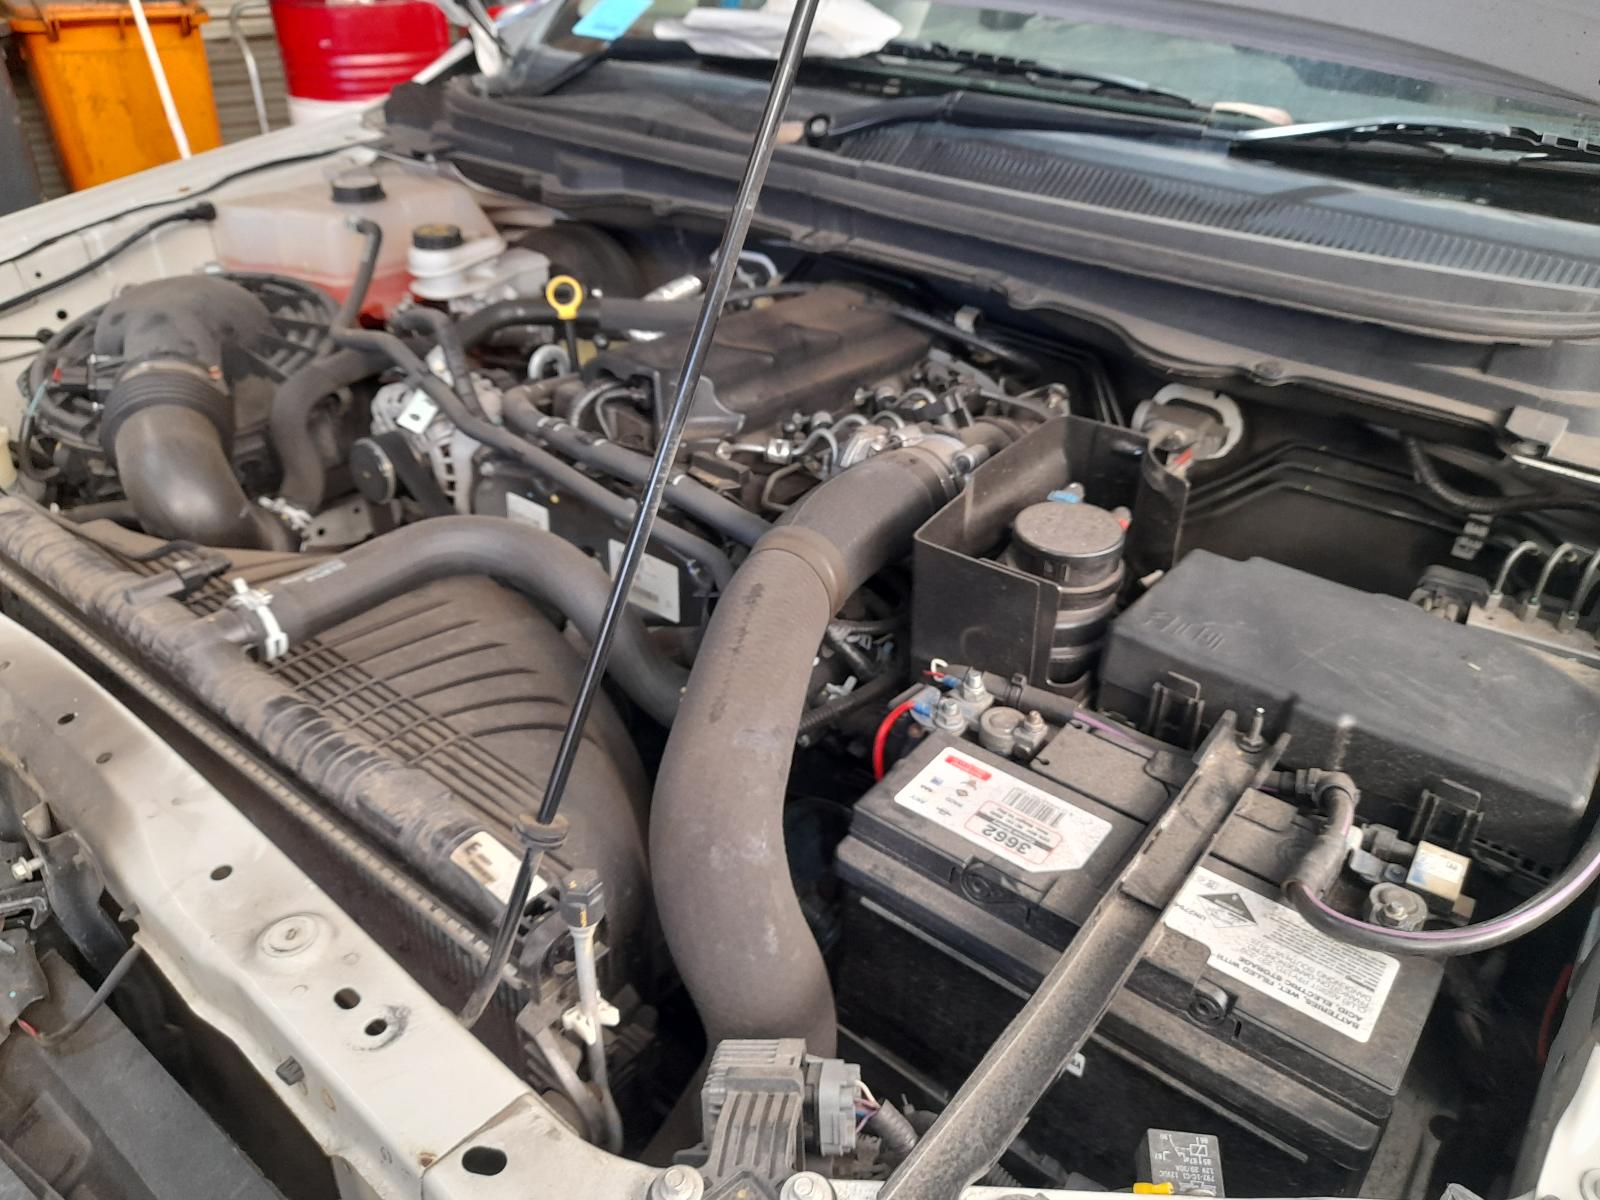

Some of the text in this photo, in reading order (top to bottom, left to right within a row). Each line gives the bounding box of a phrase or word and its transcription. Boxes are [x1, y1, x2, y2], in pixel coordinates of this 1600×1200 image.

[982, 825, 1031, 855] 3662
[1215, 953, 1359, 1029] BATTERIES, WET, FILLED WITH
[1238, 956, 1362, 1022] ACID, ELECTRIC STORAGE
